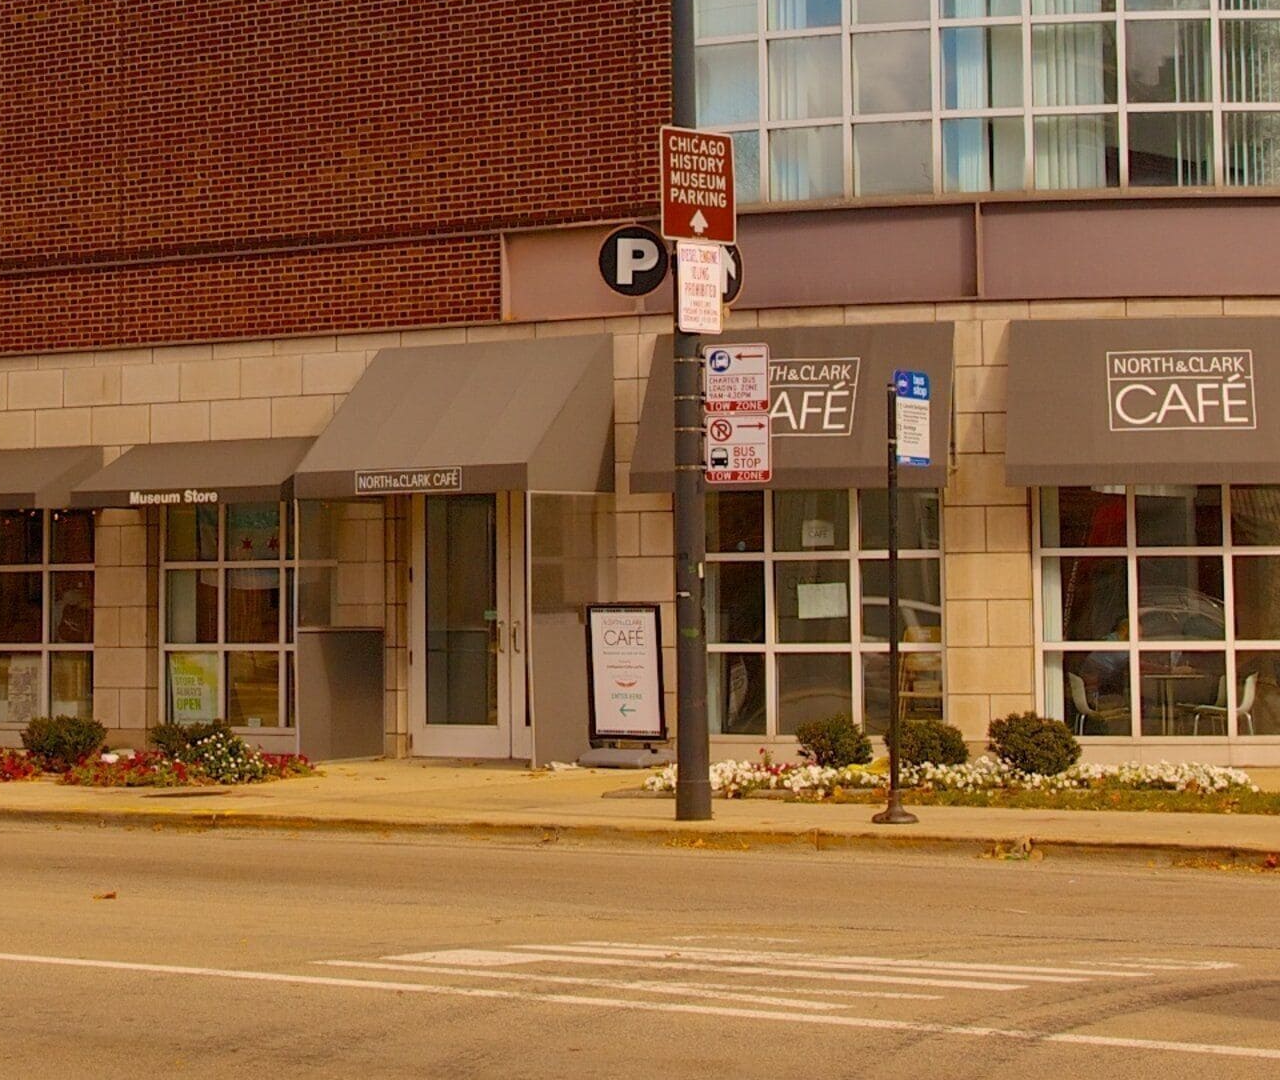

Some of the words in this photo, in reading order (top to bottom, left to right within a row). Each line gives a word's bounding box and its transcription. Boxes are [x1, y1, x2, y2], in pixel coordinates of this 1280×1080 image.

[669, 135, 725, 157] CHICAGO
[670, 153, 725, 173] HISTORY
[671, 171, 726, 191] MUSEUM
[671, 188, 727, 208] PARKING
[616, 238, 659, 285] P
[709, 401, 731, 411] TOW
[736, 400, 763, 410] ZONE
[770, 381, 850, 430] AFÉ
[1115, 373, 1248, 424] CAFÉ
[733, 446, 756, 457] BUS
[733, 458, 761, 469] STOP
[433, 469, 458, 487] CAFÉ
[711, 471, 731, 481] TOW
[738, 470, 764, 480] ZONE
[129, 491, 180, 505] Museum
[184, 489, 218, 503] Store
[603, 627, 644, 646] CAFÉ
[176, 698, 201, 711] OPEN
